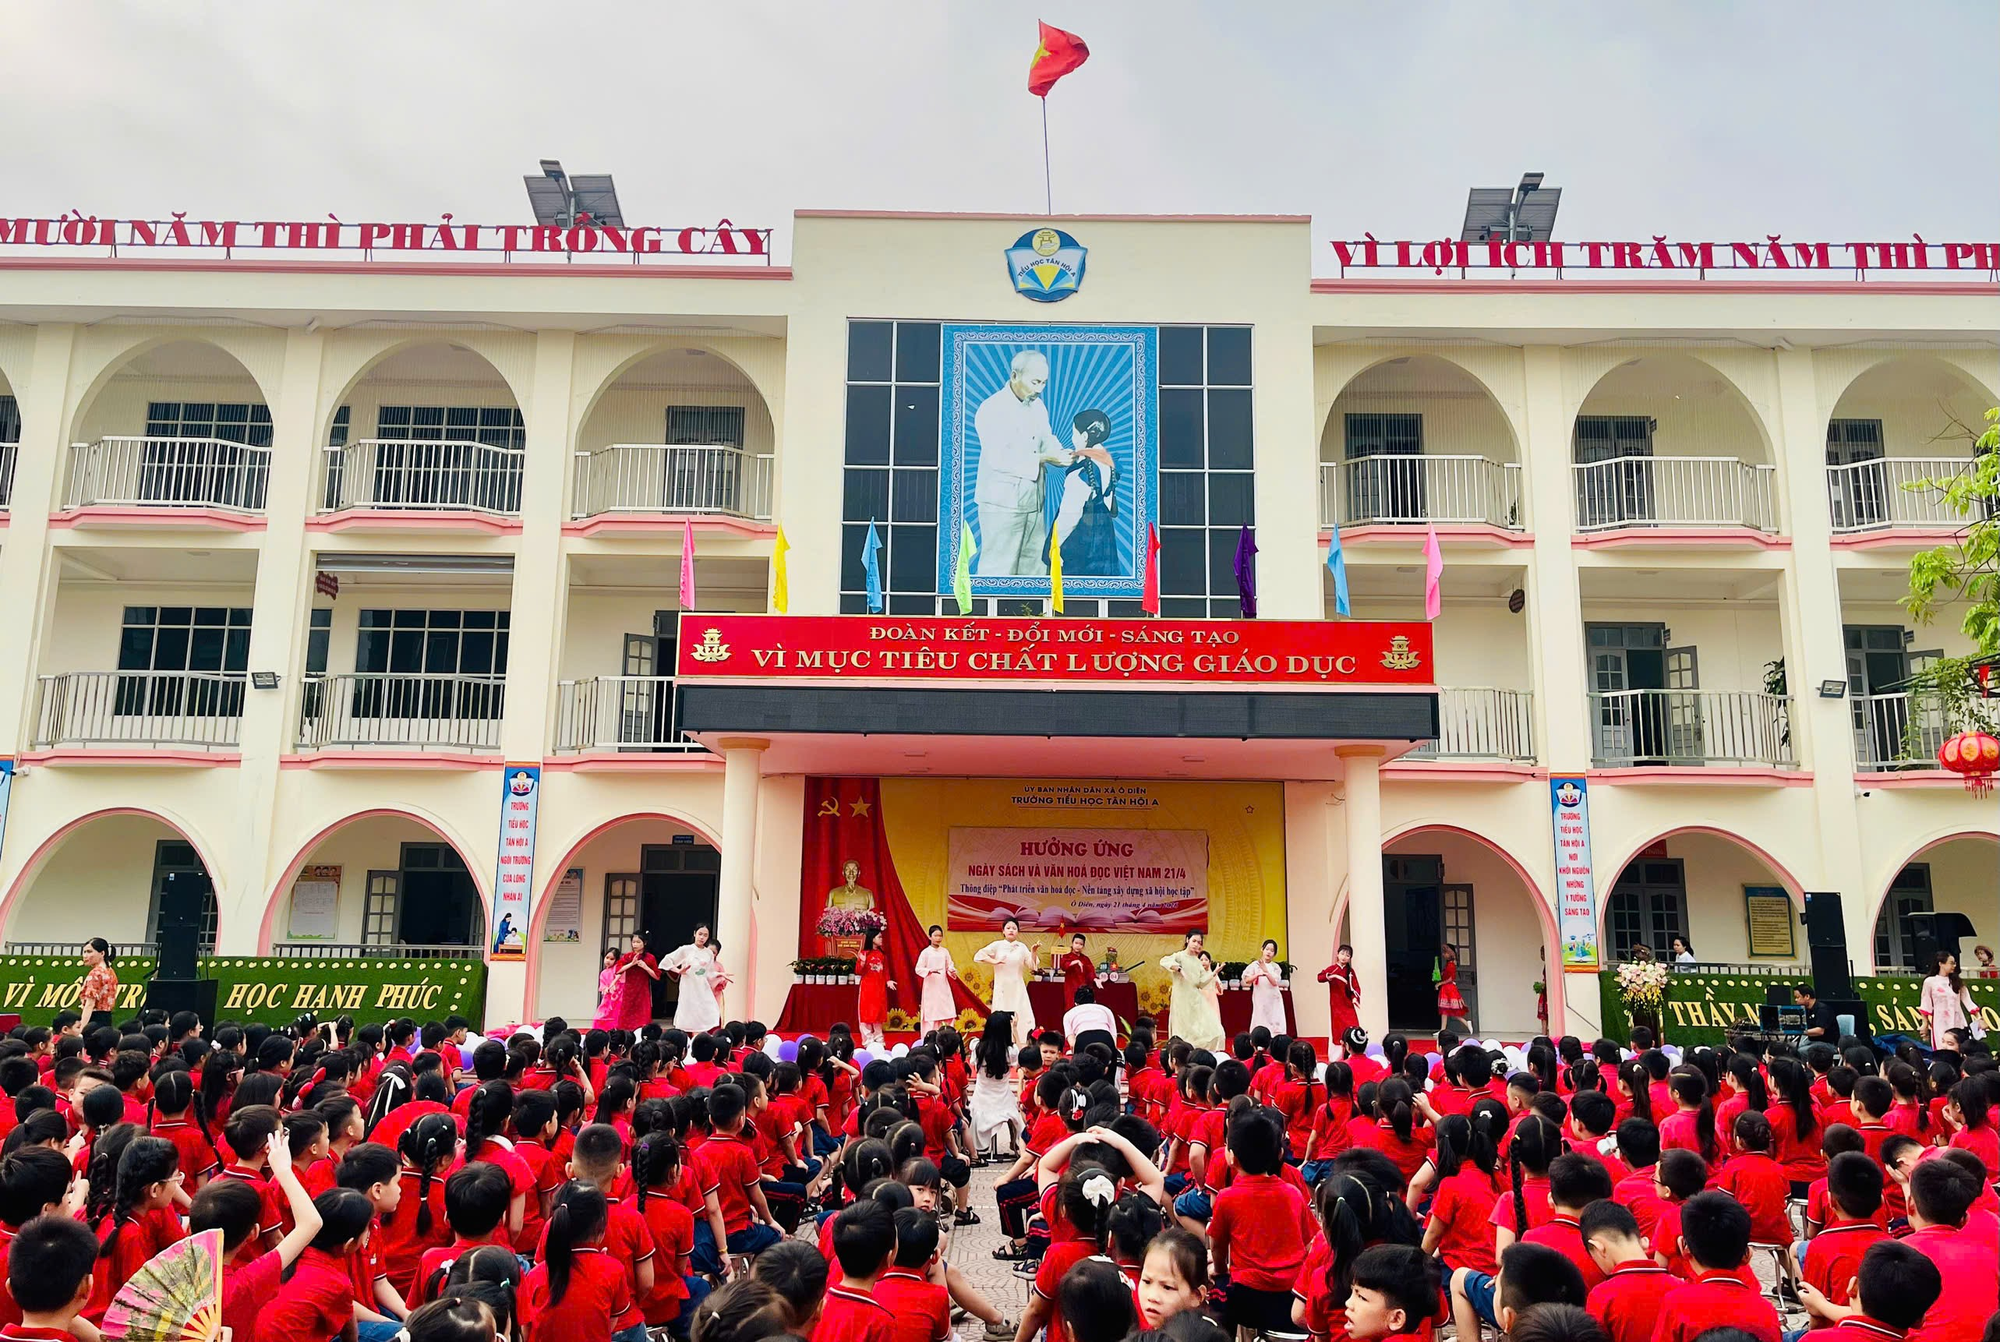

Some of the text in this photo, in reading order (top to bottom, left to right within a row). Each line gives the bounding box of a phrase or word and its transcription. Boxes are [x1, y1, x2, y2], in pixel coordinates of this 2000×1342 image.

[0, 209, 118, 246] MƯỜI
[128, 211, 240, 247] NĂM
[254, 213, 342, 248] THÌ
[358, 213, 481, 250] PHẢI
[678, 219, 773, 254] CÂY
[1330, 232, 1379, 267] VÌ
[1395, 237, 1470, 276] LỢI
[1487, 232, 1564, 268] ÍCH
[1580, 235, 1714, 269] TRĂM
[1730, 234, 1830, 269] NĂM
[1845, 233, 1928, 269] THÌ
[869, 623, 936, 641] ĐOÀN
[943, 621, 990, 641] KẾT
[1007, 621, 1050, 642] ĐỔI
[1058, 626, 1103, 643] MỚI
[1121, 625, 1185, 644] SÁNG
[1191, 630, 1240, 648] TẠO
[751, 642, 786, 668] VÌ
[796, 650, 871, 673] MỤC
[879, 646, 960, 670] TIÊU
[968, 643, 1058, 671] CHẤT
[1193, 648, 1278, 674] GIÁO
[1286, 656, 1357, 679] DỤC
[1011, 795, 1053, 804] TRƯỜNG
[1057, 794, 1076, 804] TIỂU
[1080, 798, 1103, 806] HỌC
[1107, 796, 1126, 805] TÂN
[1130, 797, 1148, 807] HỘI
[1057, 785, 1080, 793] NHÂN
[1020, 837, 1134, 857] HƯỞNG ỨNG
[968, 863, 1186, 880] NGÀY SÁCH VÀ VĂN HOÁ ĐỌC VIỆT NAM 21/4
[960, 884, 981, 894] Thông
[983, 884, 997, 895] điệp
[1019, 882, 1035, 893] triển
[1064, 885, 1075, 896] đọc
[1126, 886, 1143, 897] dựng
[1154, 886, 1164, 897] hội
[1166, 886, 1178, 897] học
[3, 976, 35, 1008] VÌ
[224, 982, 288, 1016] HỌC
[291, 984, 368, 1017] HẠNH
[375, 976, 443, 1010] PHÚC
[1668, 986, 1735, 1027] THẦY
